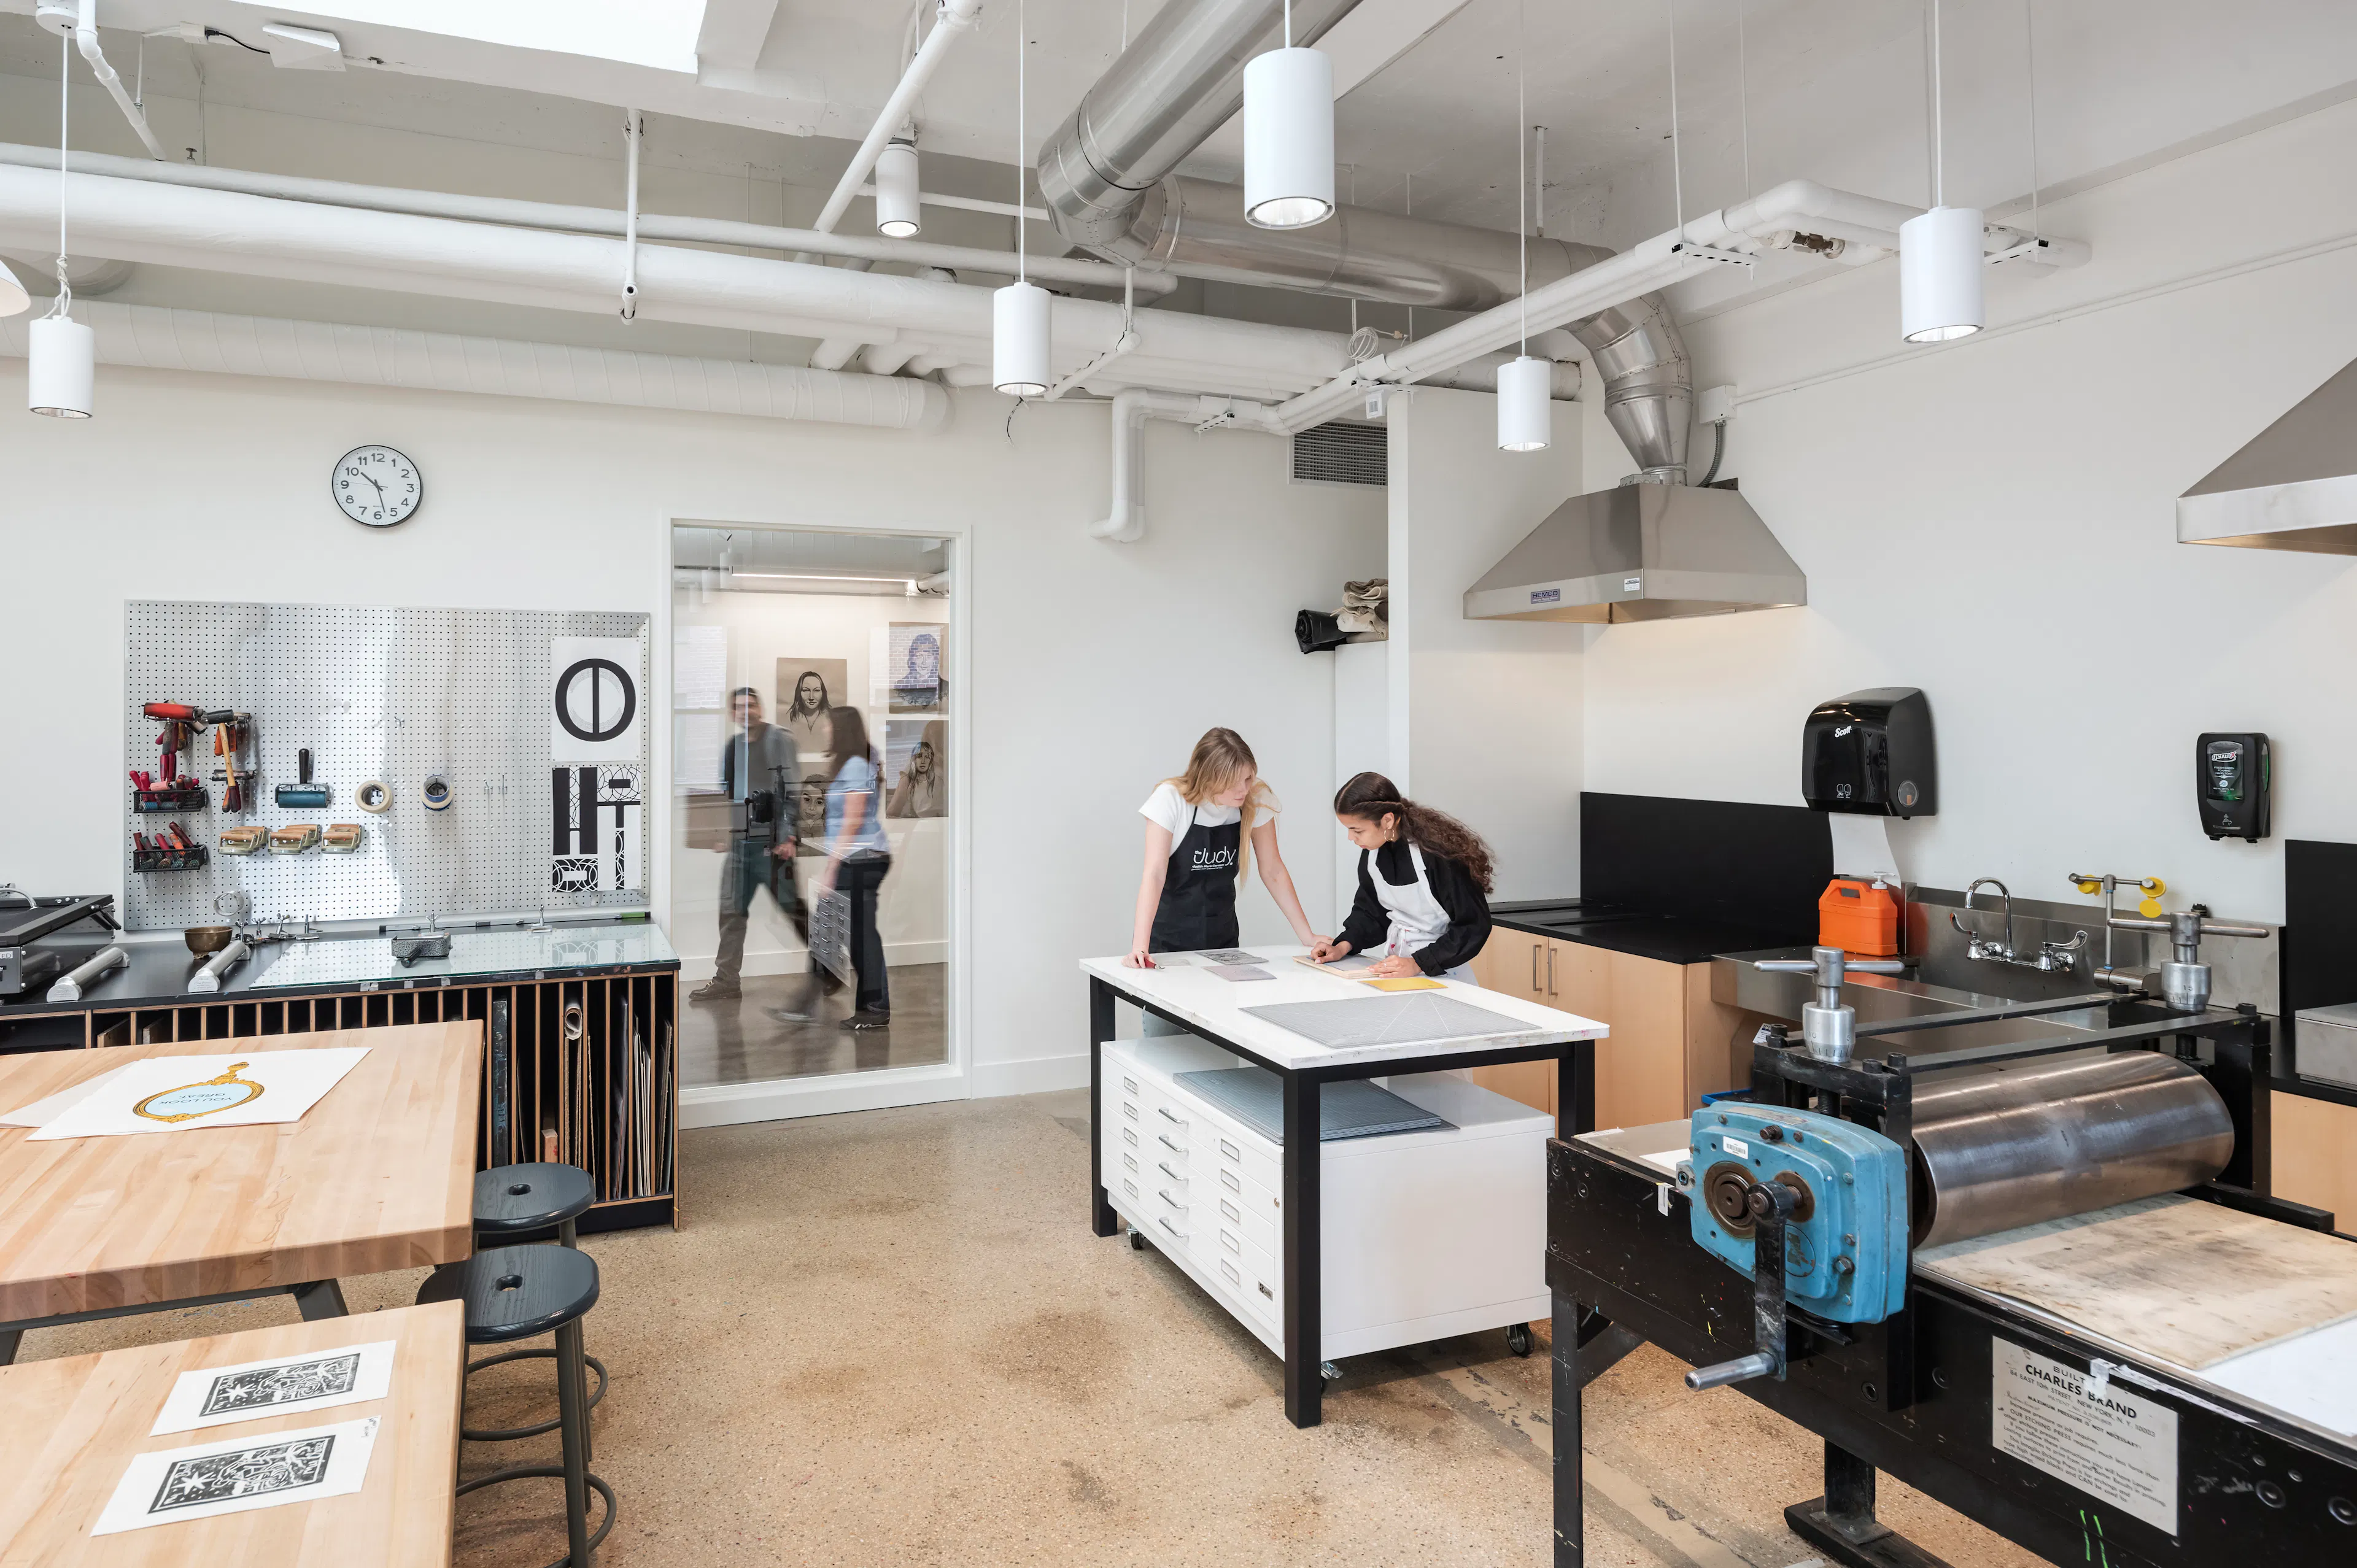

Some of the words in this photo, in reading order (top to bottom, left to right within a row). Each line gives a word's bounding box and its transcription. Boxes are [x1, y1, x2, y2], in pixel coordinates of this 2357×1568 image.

[358, 457, 367, 465] 11
[371, 453, 385, 462] 12
[391, 458, 396, 467] 1
[345, 466, 359, 476] 10
[401, 469, 409, 478] 2
[341, 480, 349, 489] 9
[406, 484, 414, 493] 3
[346, 495, 354, 504] 8
[401, 498, 409, 507] 4
[358, 506, 367, 515] 7
[390, 508, 398, 517] 5
[373, 511, 382, 520] 6
[1835, 725, 1851, 738] Scott
[2053, 1365, 2084, 1383] BUILT
[2019, 1373, 2034, 1383] EAST
[2076, 1399, 2091, 1409] NEW
[2025, 1364, 2081, 1395] CHARLES
[2088, 1391, 2136, 1418] BRAND
[2010, 1400, 2031, 1413] Increase
[2032, 1412, 2054, 1425] pressure
[2027, 1396, 2055, 1410] MAXIMUM
[2057, 1408, 2082, 1423] PRESSURE
[2010, 1408, 2022, 1418] OUR
[2025, 1415, 2051, 1431] ETCHING
[2053, 1428, 2071, 1440] PRESS
[2018, 1420, 2038, 1432] etching
[2009, 1435, 2019, 1443] This
[2042, 1450, 2061, 1464] Etching
[2078, 1475, 2092, 1485] CAN
